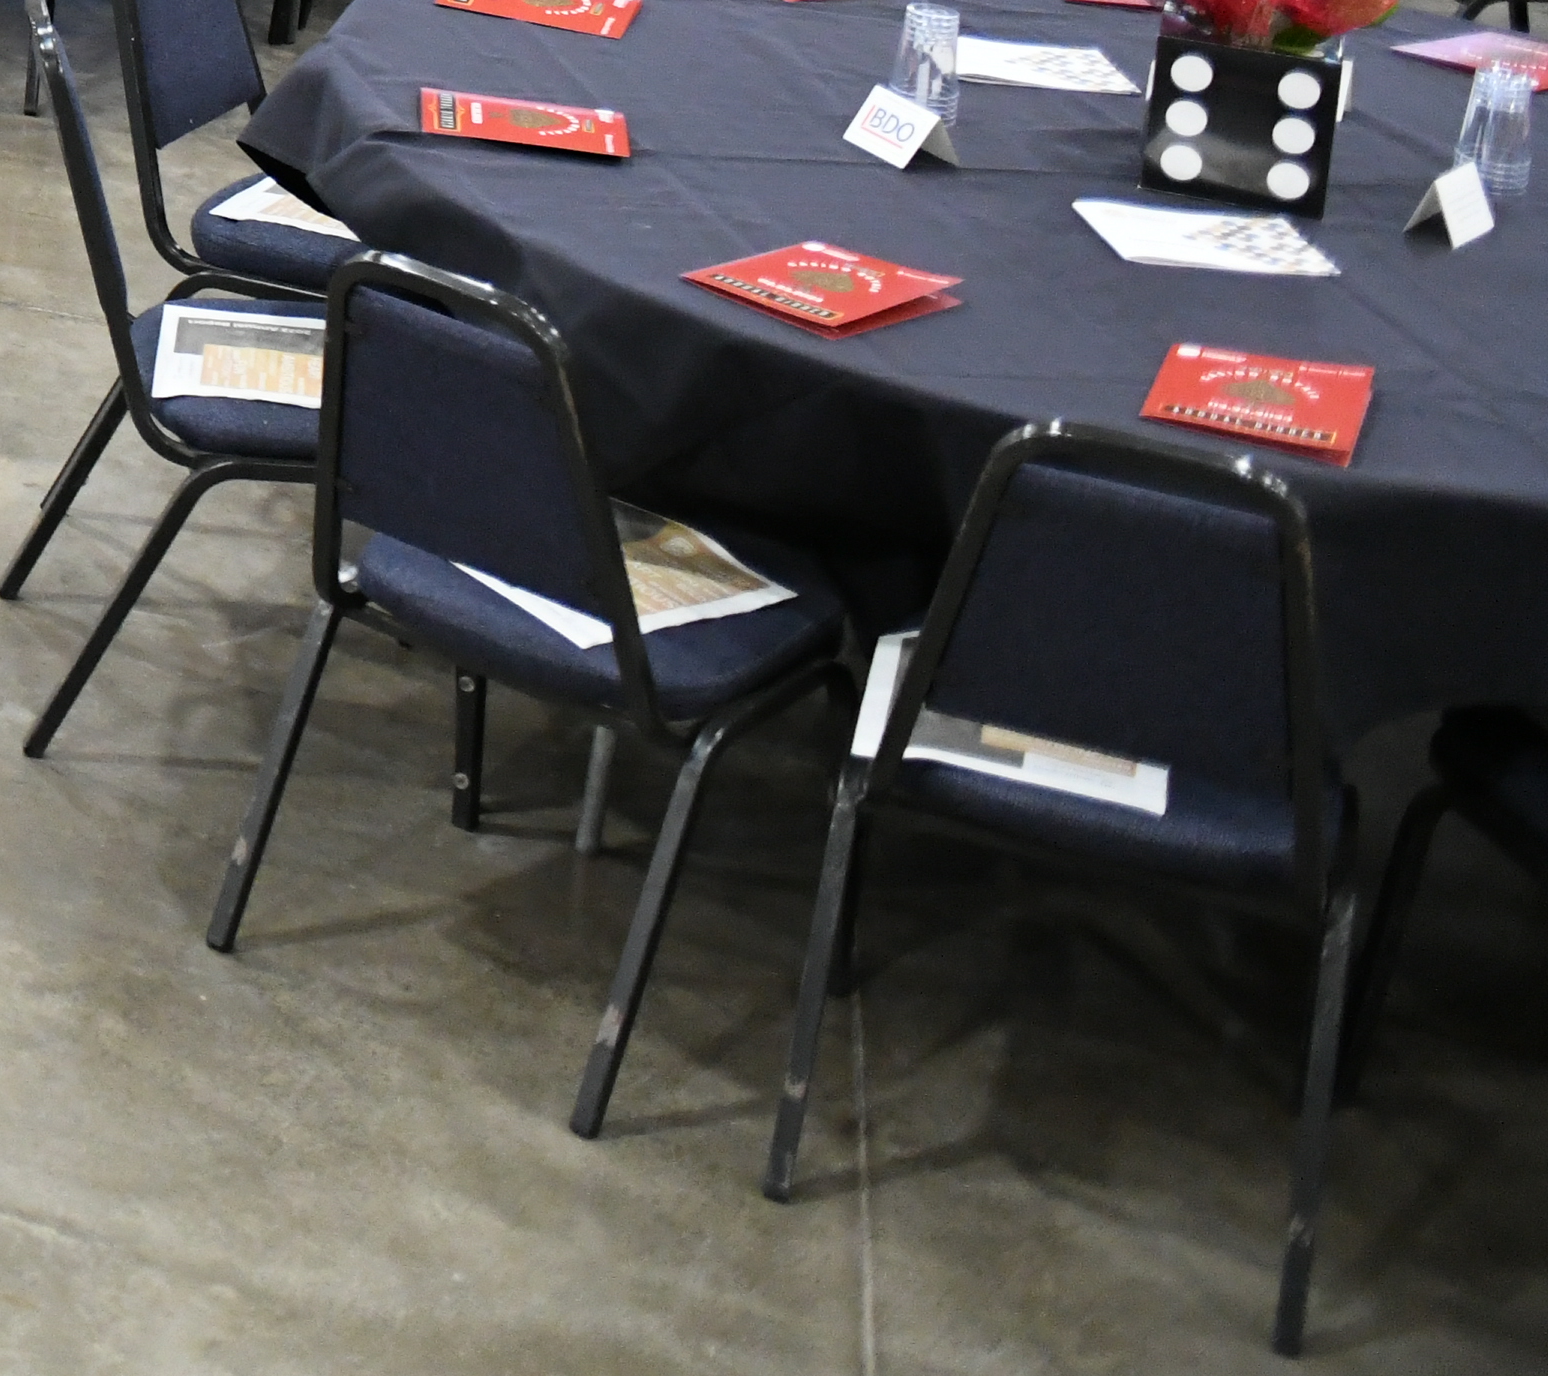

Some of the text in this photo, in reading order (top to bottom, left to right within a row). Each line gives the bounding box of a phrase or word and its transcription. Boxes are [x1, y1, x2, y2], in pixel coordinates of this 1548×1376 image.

[871, 107, 915, 142] BDO
[1172, 405, 1244, 426] ANNUAL
[1254, 421, 1323, 440] DINNER
